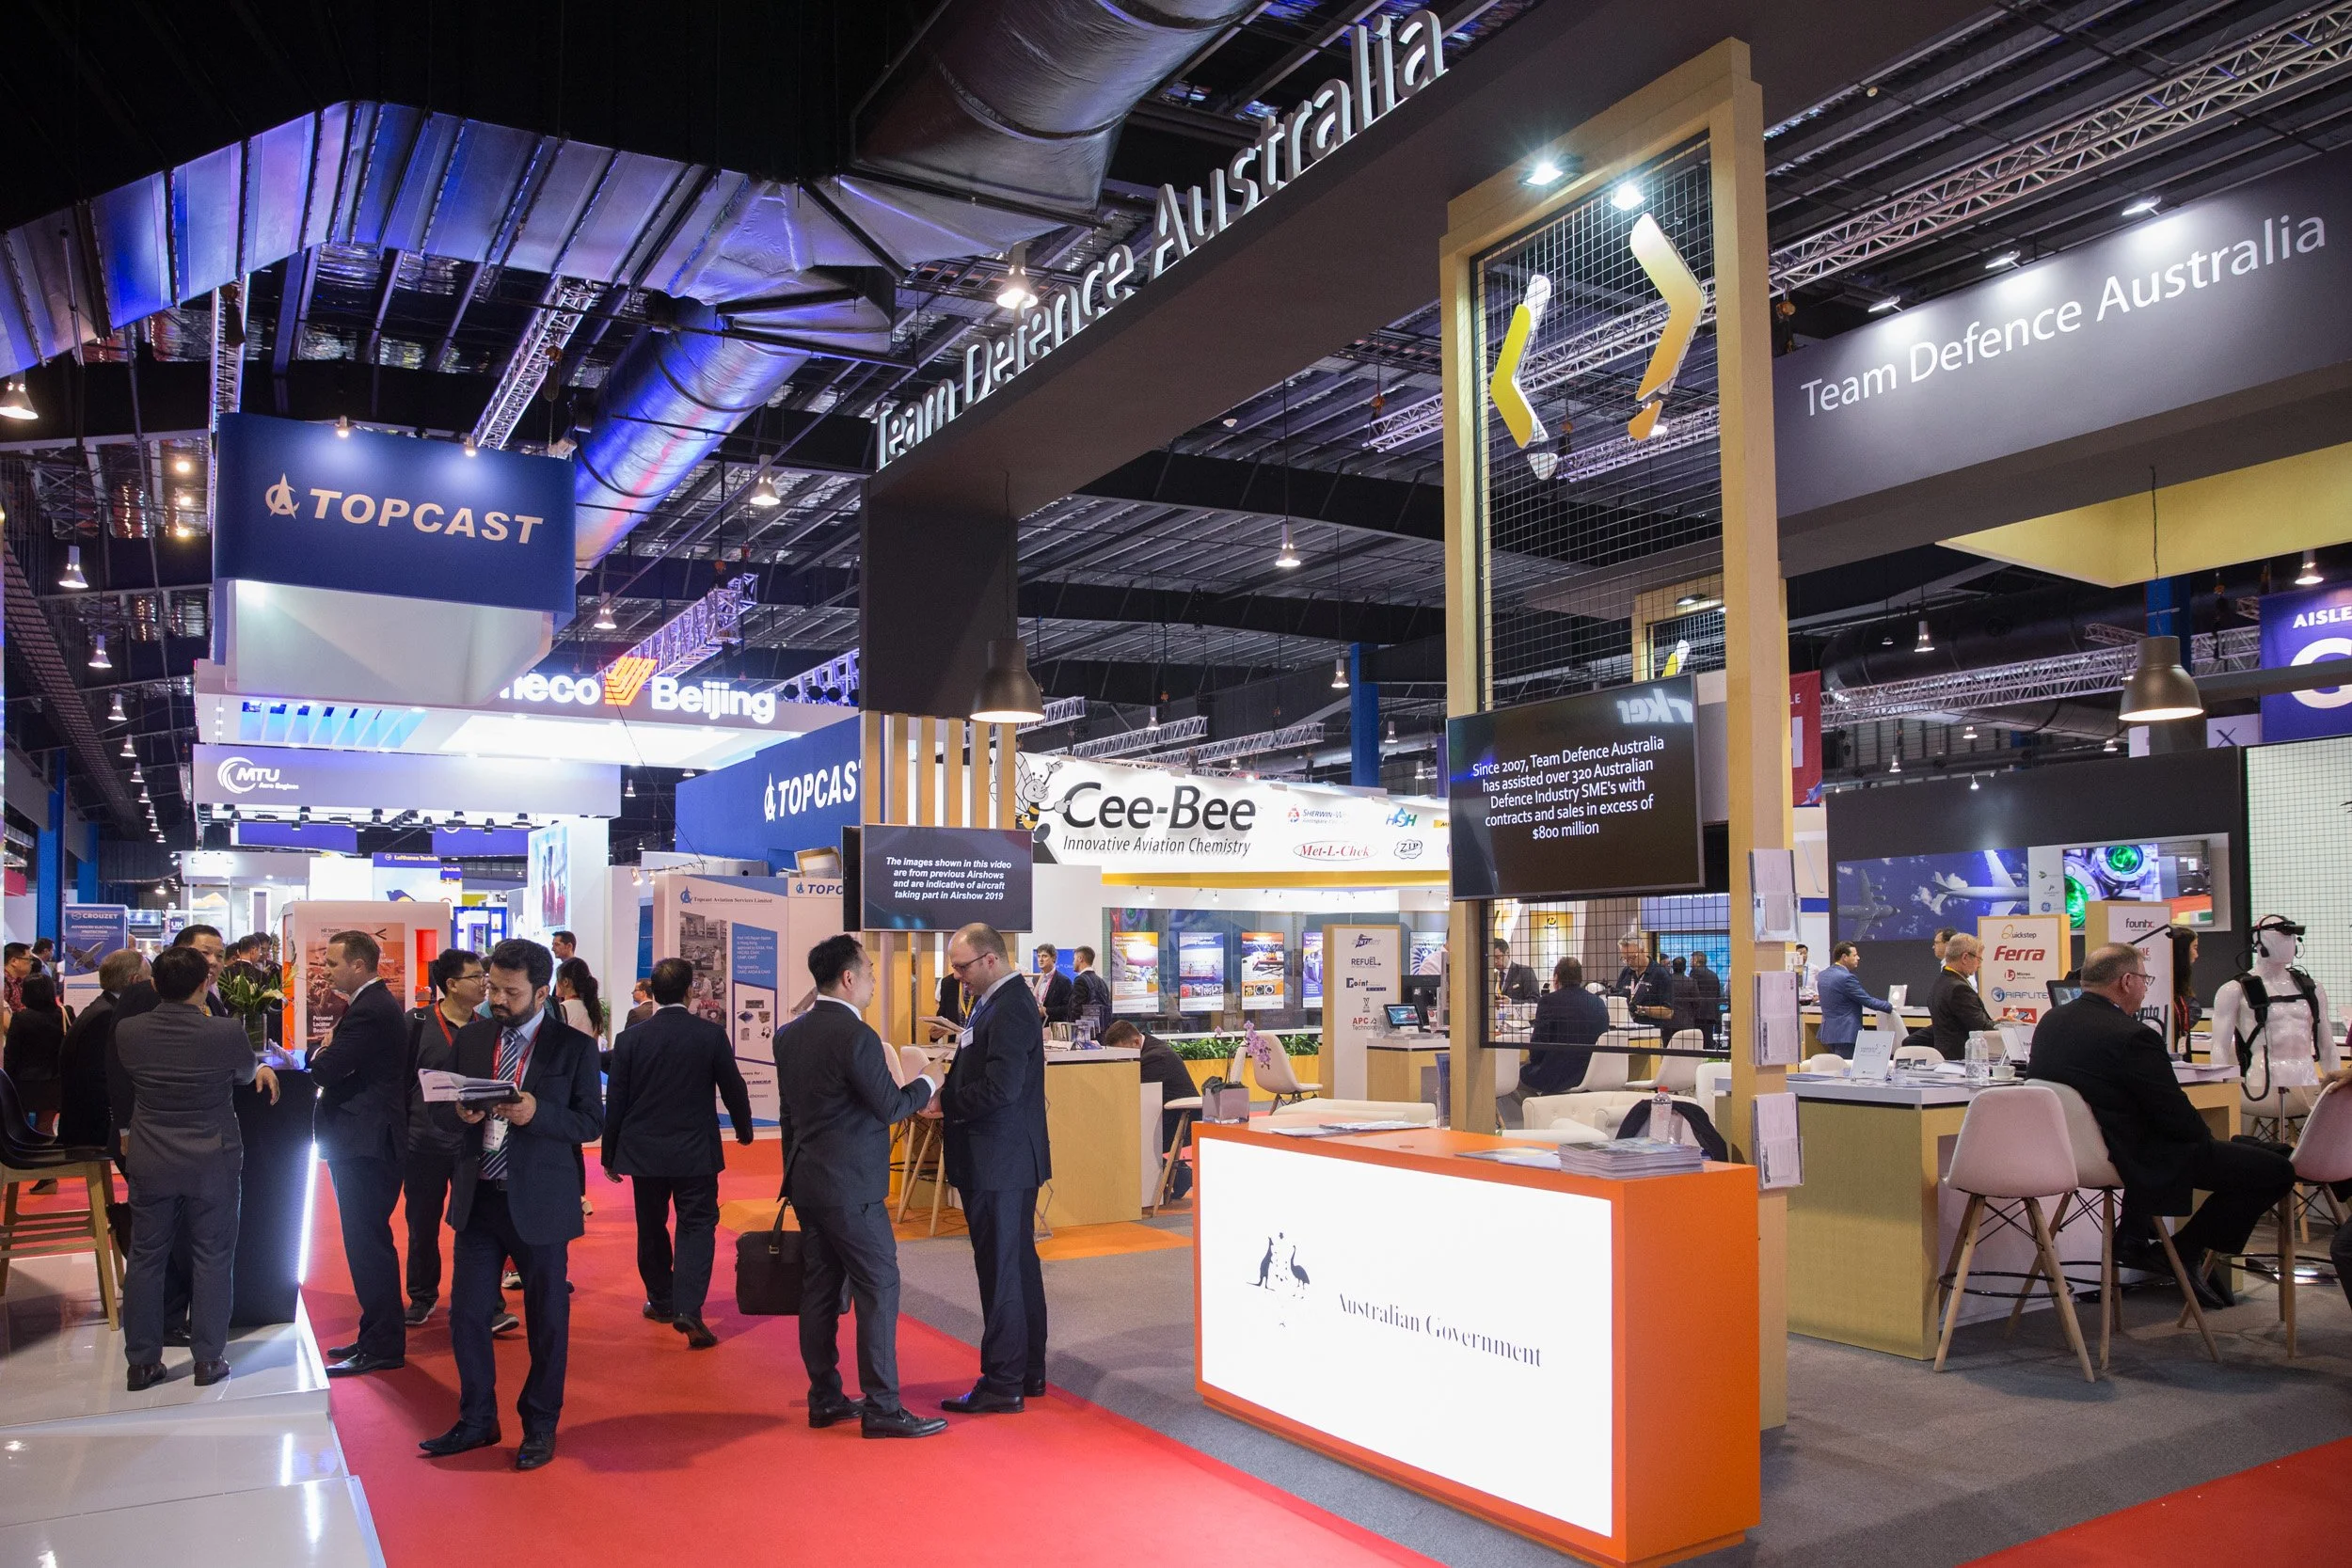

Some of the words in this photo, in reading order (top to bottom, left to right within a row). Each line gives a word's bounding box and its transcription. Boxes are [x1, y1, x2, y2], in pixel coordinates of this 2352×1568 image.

[872, 380, 954, 470] Team
[963, 245, 1133, 410] Defence
[1148, 10, 1448, 283] Australia
[1801, 364, 1897, 416] Team
[1909, 300, 2082, 384] Defence
[2096, 214, 2326, 322] Australia
[310, 486, 544, 545] TOPCAST
[2293, 606, 2352, 629] AISLE
[651, 674, 776, 725] Beijing
[1472, 764, 1500, 777] Since
[1502, 759, 1529, 773] 2007,
[1530, 753, 1560, 768] Team
[1562, 746, 1610, 764] Defence
[1611, 735, 1664, 757] Australia
[236, 767, 280, 783] MTU
[1483, 779, 1501, 793] has
[1502, 770, 1544, 791] assisted
[1545, 770, 1569, 784] over
[1571, 768, 1592, 784] 320
[1593, 757, 1654, 779] Australian
[778, 759, 861, 817] TOPCAS
[1490, 793, 1533, 809] Defence
[1534, 787, 1580, 803] Industry
[1581, 781, 1616, 799] SME's
[1618, 776, 1645, 794] with
[1062, 781, 1256, 833] Cee-Bee
[1485, 810, 1533, 827] contracts
[1534, 805, 1555, 822] and
[1557, 803, 1584, 819] sales
[1586, 801, 1597, 816] in
[1599, 800, 1639, 816] excess
[1640, 793, 1654, 810] of
[1385, 812, 1418, 828] HSH
[1532, 825, 1560, 841] $800
[1561, 820, 1599, 837] million
[1063, 834, 1130, 852] Innovative
[1133, 837, 1185, 855] Aviation
[1188, 838, 1251, 859] Chemistry
[1299, 844, 1370, 857] Met-L-Chek
[1400, 842, 1419, 853] ZIP
[886, 856, 902, 865] The
[903, 857, 933, 868] images
[934, 858, 962, 867] shown
[962, 859, 972, 868] in
[973, 859, 989, 868] this
[990, 860, 1012, 869] video
[909, 868, 929, 878] from
[930, 869, 965, 879] previous
[966, 870, 1005, 879] Airshows
[893, 879, 910, 888] and
[926, 879, 965, 889] indicative
[966, 880, 977, 890] of
[977, 880, 1006, 890] aircraft
[895, 890, 921, 900] taking
[921, 891, 940, 900] part
[940, 891, 948, 899] in
[949, 891, 984, 900] Airshow
[984, 892, 1004, 900] 2019
[1351, 957, 1380, 966] REFUEL
[1993, 945, 2046, 961] Ferra
[1339, 1292, 1420, 1333] Australian
[1426, 1315, 1541, 1368] Government
